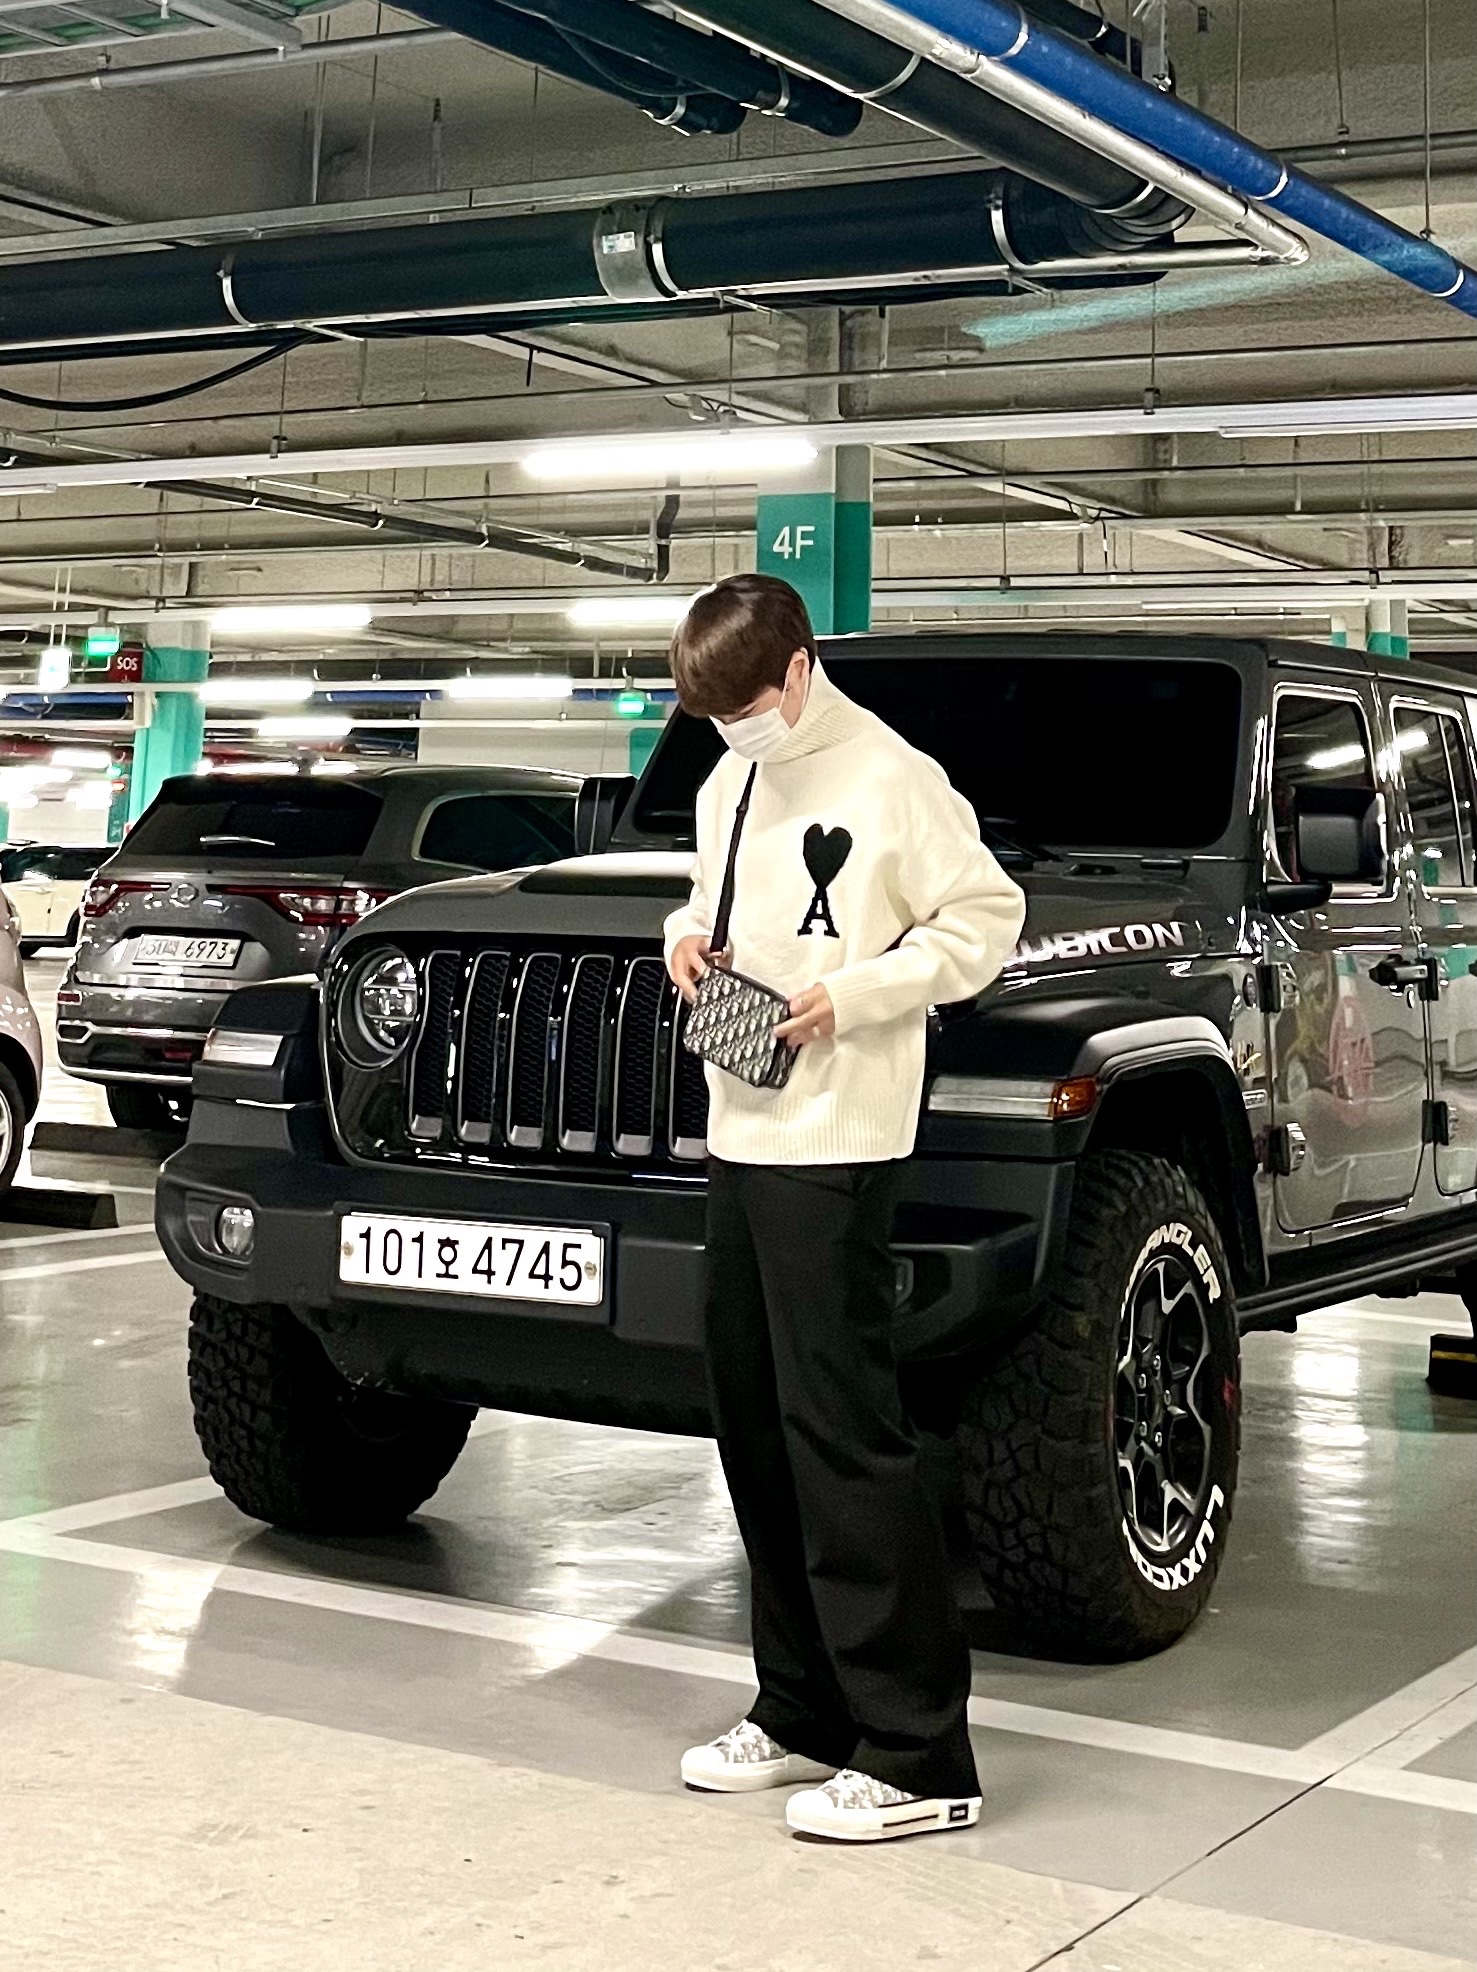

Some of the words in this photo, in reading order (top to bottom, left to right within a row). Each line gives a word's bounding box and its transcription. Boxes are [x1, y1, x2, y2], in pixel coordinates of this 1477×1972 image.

[772, 525, 816, 560] 4F
[116, 656, 139, 671] SOS
[797, 886, 840, 939] A
[1003, 921, 1186, 967] UBICON
